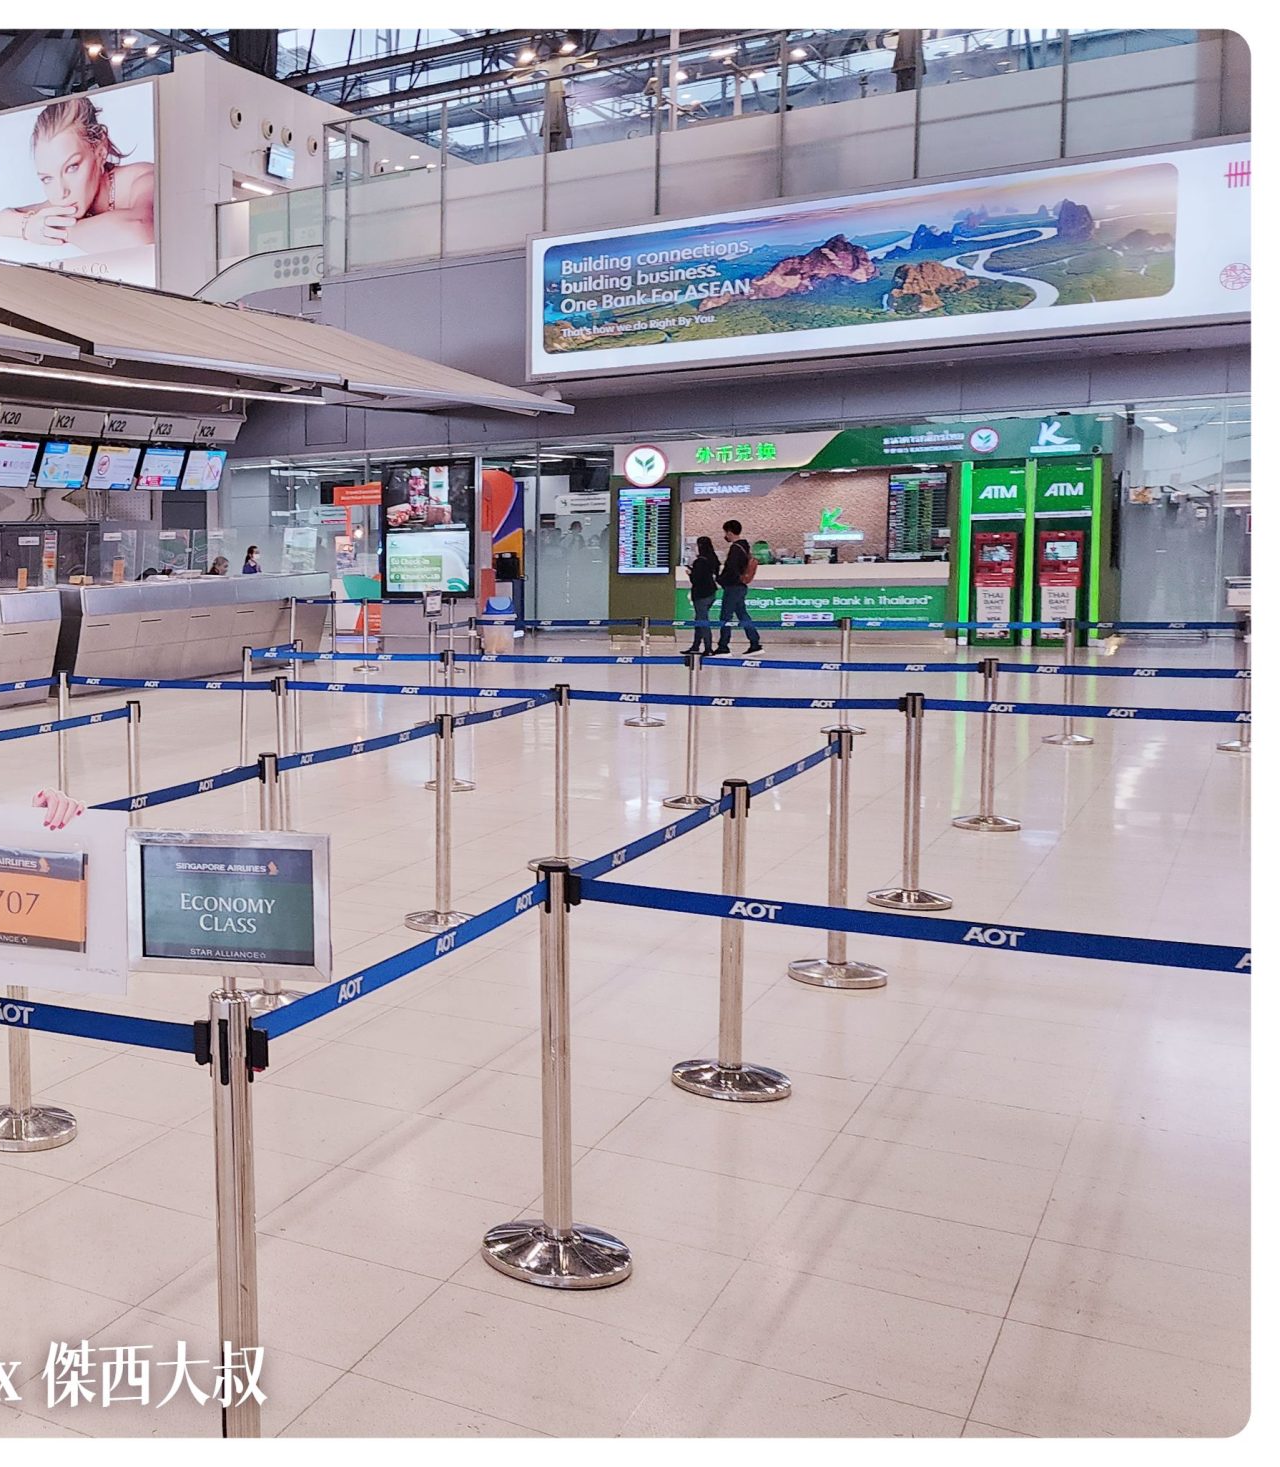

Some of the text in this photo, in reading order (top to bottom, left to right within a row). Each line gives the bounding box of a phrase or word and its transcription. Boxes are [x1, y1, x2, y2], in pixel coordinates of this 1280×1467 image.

[561, 239, 754, 276] Building connections,
[561, 263, 721, 295] building business.
[560, 278, 755, 314] One Bank For ASEAN.
[562, 313, 717, 338] That's how we do Right By You.
[0, 411, 22, 425] K20
[55, 414, 76, 428] K21
[107, 419, 125, 432] K22
[155, 423, 173, 436] K23
[200, 424, 215, 438] K24
[694, 485, 751, 495] EXCHANGE
[978, 485, 1018, 500] ATM
[1044, 482, 1084, 497] ATM
[774, 596, 876, 607] Exchange Bank in
[1132, 668, 1159, 678] AOT
[619, 694, 642, 703] AOT
[711, 697, 736, 707] AOT
[810, 700, 836, 709] AOT
[987, 703, 1017, 713] AOT
[1107, 709, 1138, 719] AOT
[197, 780, 215, 793] AOT
[130, 795, 148, 811] AOT
[611, 849, 627, 868] AOT
[175, 862, 267, 873] SINGAPORE AIRLINES
[180, 892, 276, 914] ECONOMY
[515, 890, 534, 913] AOT
[729, 900, 782, 921] AOT
[199, 913, 257, 934] CLASS
[435, 932, 457, 956] AOT
[962, 926, 1025, 949] AOT
[190, 948, 260, 959] STAR ALLIANCE
[338, 977, 364, 1004] AOT
